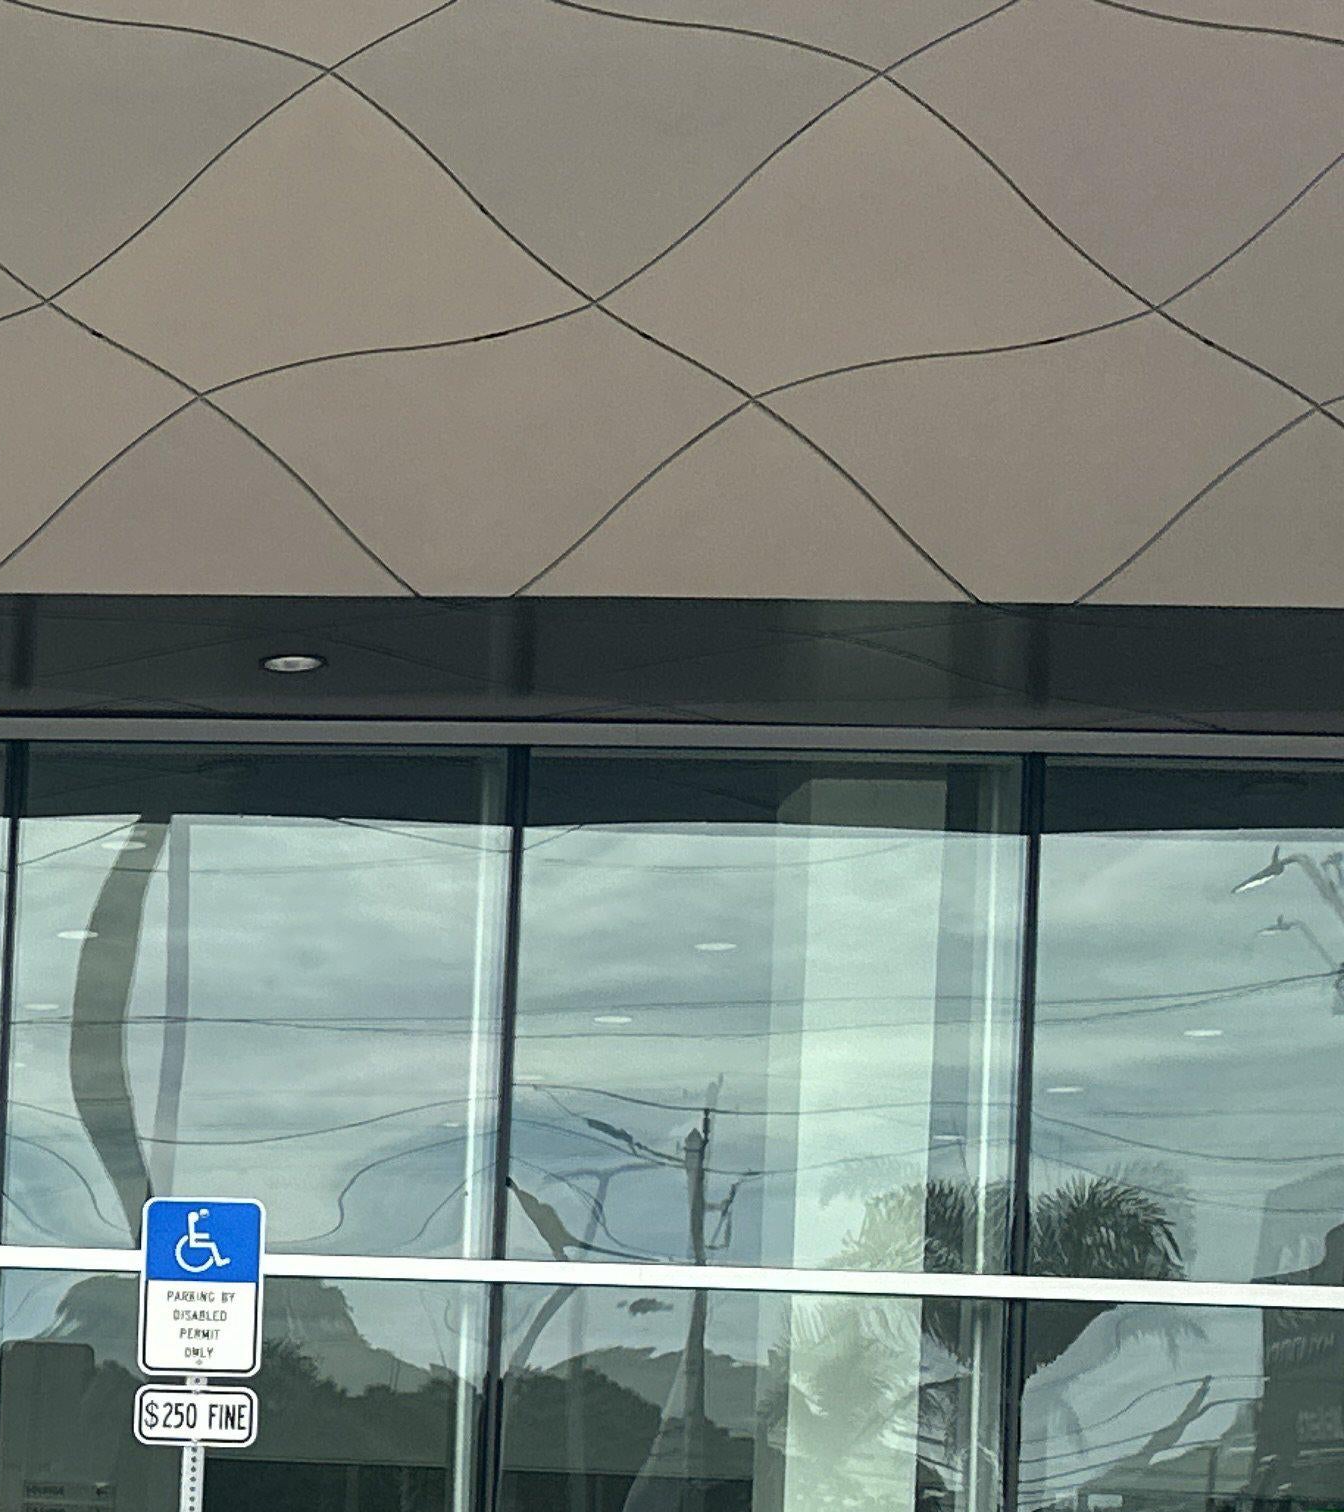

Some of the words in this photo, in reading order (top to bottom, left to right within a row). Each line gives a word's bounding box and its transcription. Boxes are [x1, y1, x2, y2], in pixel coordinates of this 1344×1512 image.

[167, 1290, 215, 1303] PARKING
[221, 1292, 236, 1304] BY
[173, 1309, 228, 1322] DISABLED
[179, 1327, 221, 1341] PERMIT
[184, 1347, 214, 1359] ONLY
[144, 1400, 198, 1430] $250
[208, 1404, 248, 1431] FINE
